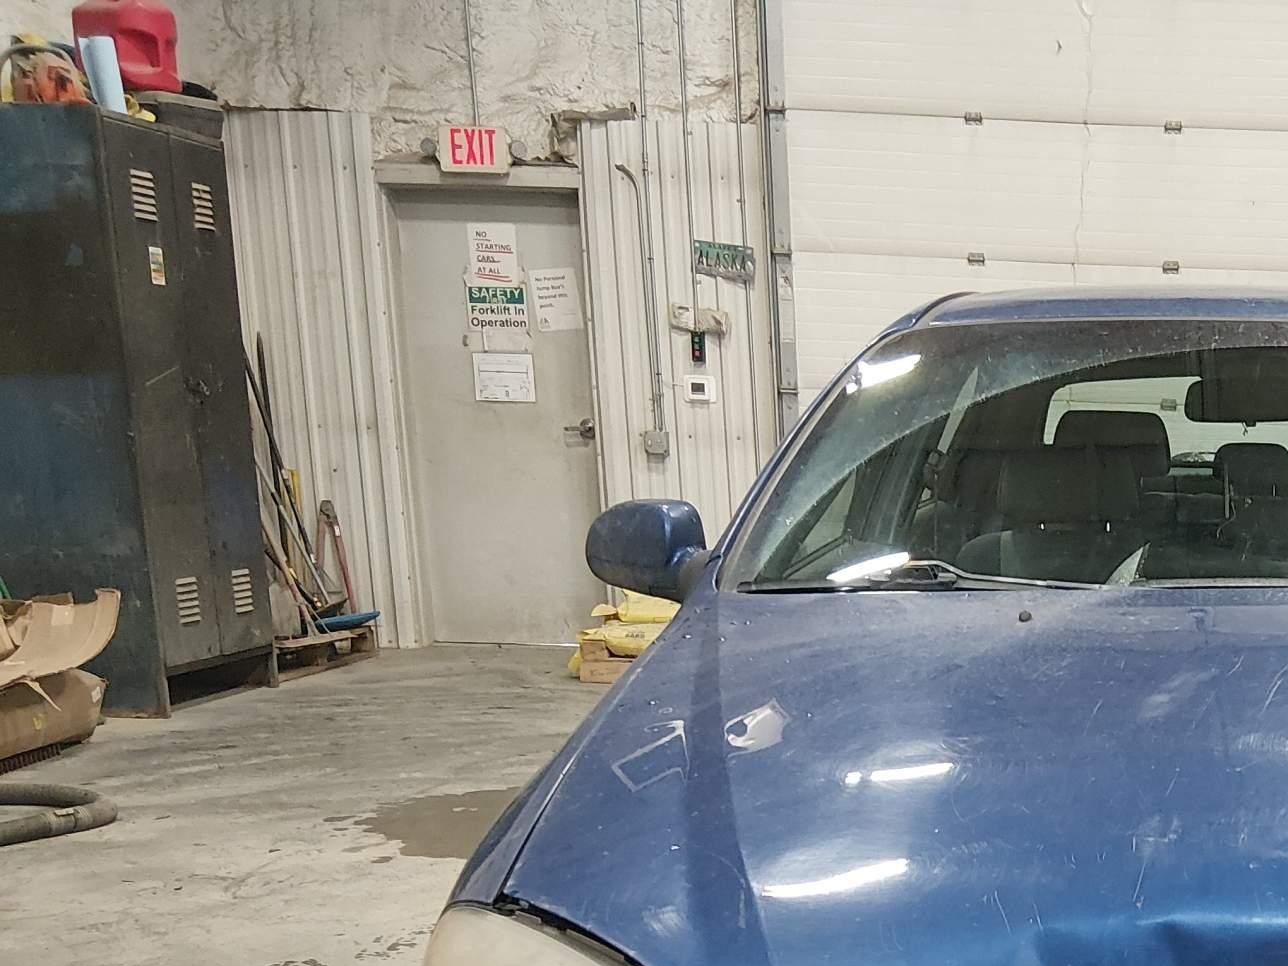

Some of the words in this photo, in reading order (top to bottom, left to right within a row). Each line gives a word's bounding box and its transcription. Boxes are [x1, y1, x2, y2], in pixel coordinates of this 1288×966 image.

[450, 128, 496, 165] EXIT
[475, 242, 512, 251] STARTING
[697, 249, 746, 272] ALASKA
[471, 287, 521, 299] SAFETY
[471, 305, 512, 316] Forklift
[514, 305, 525, 316] In
[471, 316, 527, 329] Operation
